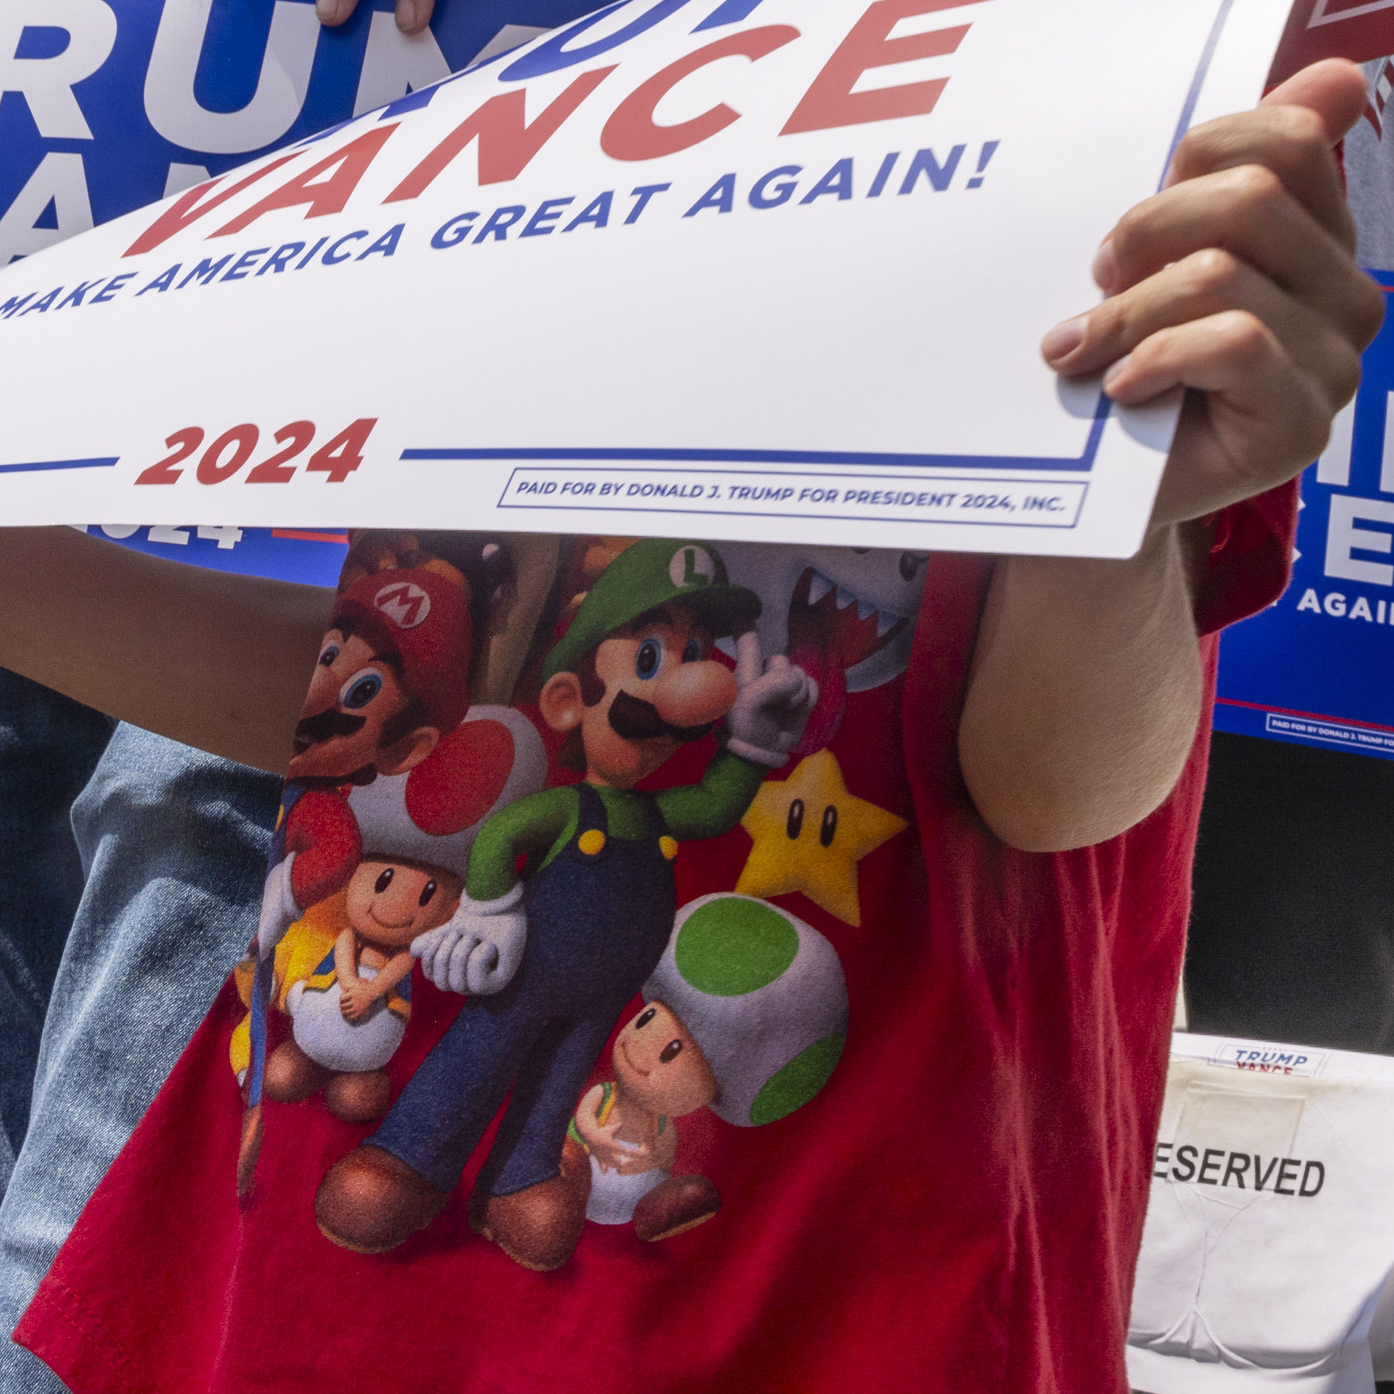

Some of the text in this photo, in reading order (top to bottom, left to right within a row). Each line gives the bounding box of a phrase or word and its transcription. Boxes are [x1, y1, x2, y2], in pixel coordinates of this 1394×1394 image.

[133, 223, 406, 298] AMERICA
[429, 183, 672, 251] GREAT
[683, 140, 1000, 219] AGAIN!
[134, 418, 379, 486] 2024
[516, 481, 1066, 513] PAID FOR BY DONALD J. TRUMP FOR PRESIDENT 2024, INC.
[1235, 1049, 1308, 1067] TRUMP
